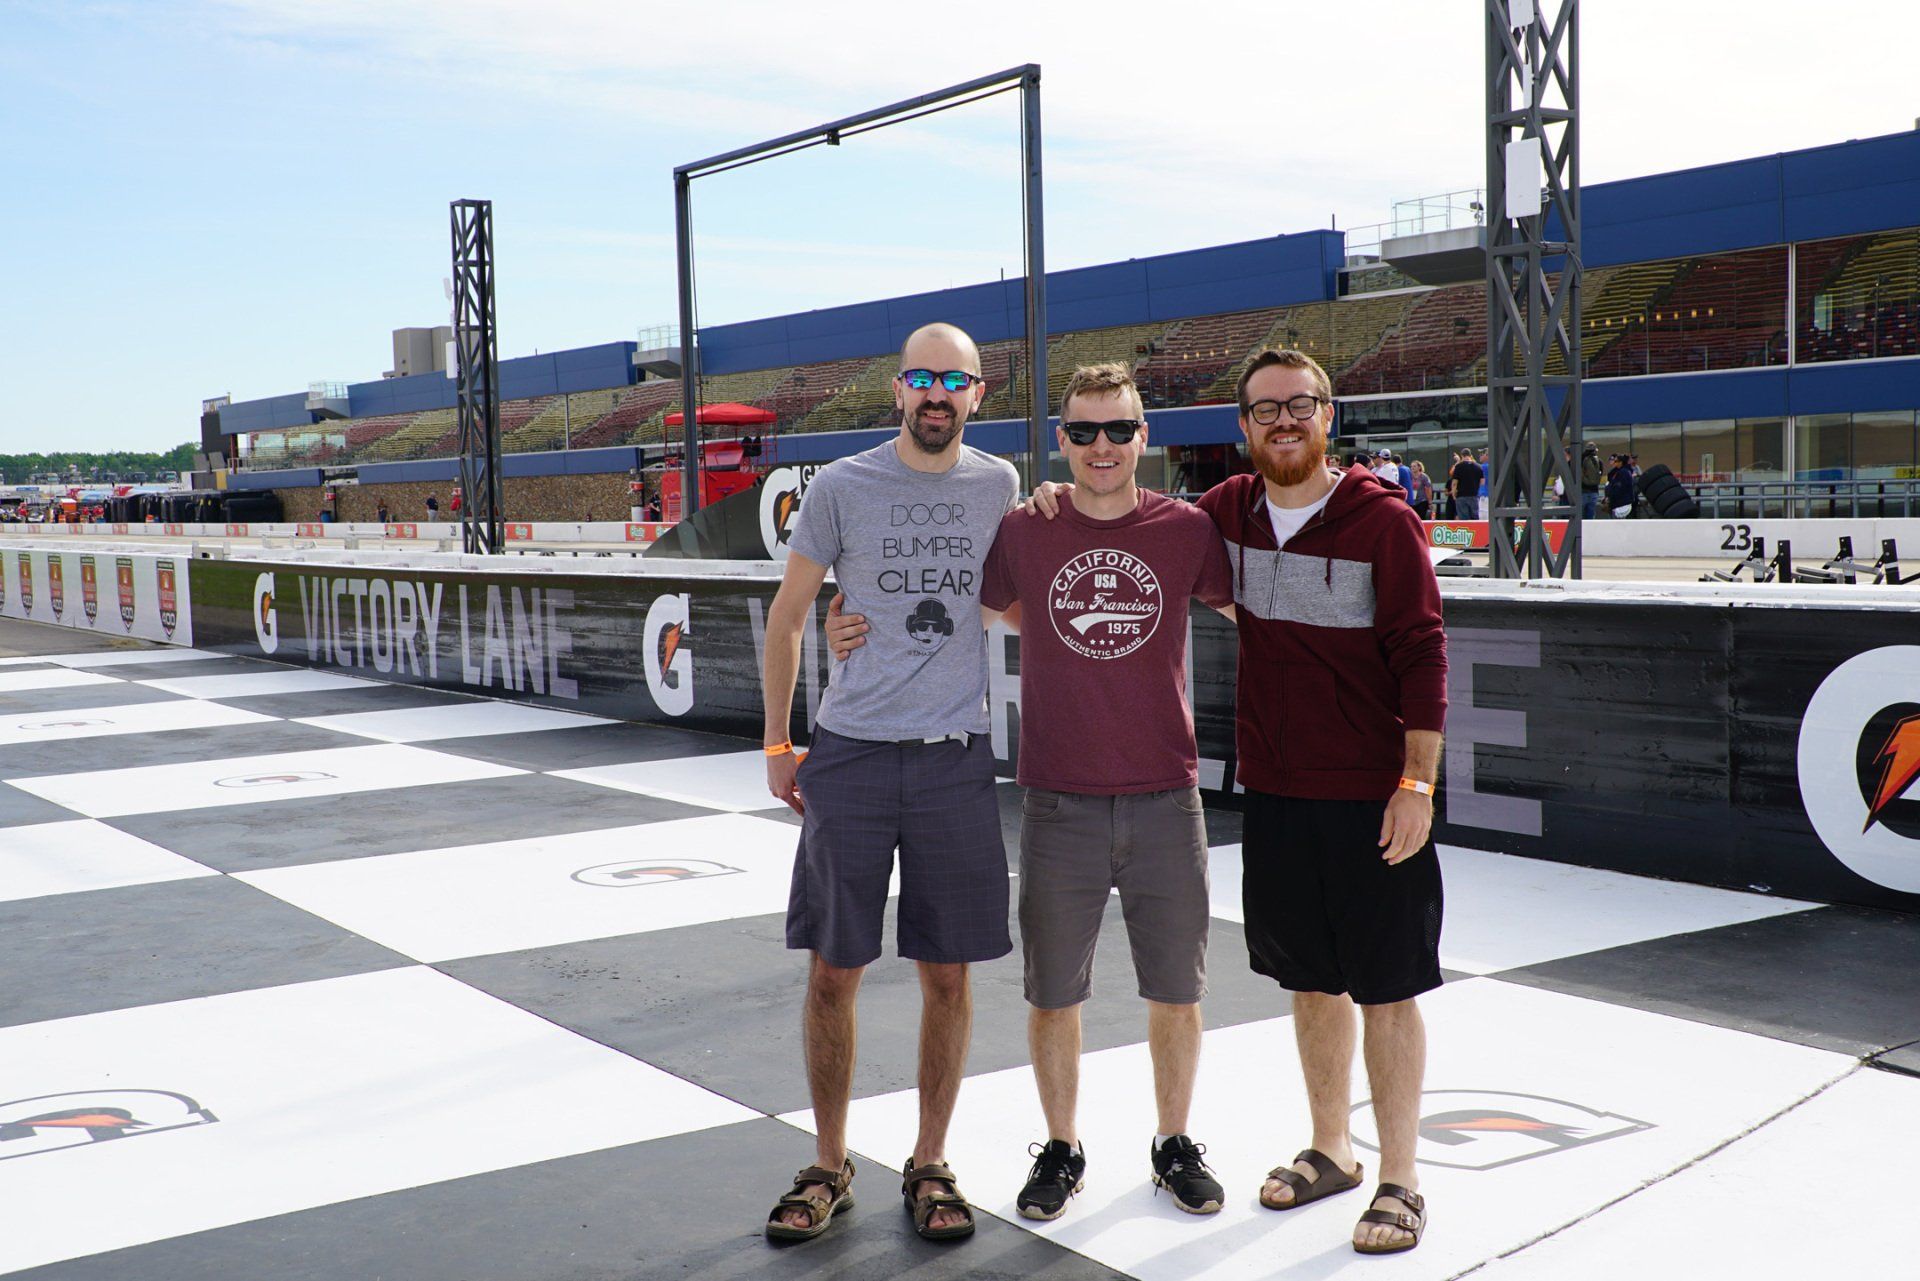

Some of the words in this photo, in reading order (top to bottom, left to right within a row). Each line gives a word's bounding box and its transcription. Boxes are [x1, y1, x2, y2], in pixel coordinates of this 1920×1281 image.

[891, 503, 967, 527] DOOR.
[1432, 525, 1473, 547] O'Reilly
[1721, 524, 1751, 550] 23
[883, 536, 975, 559] BUMPER.
[877, 569, 974, 596] CLEAR.
[1055, 552, 1157, 595] CALIFORNIA
[1094, 574, 1117, 588] USA
[1053, 591, 1085, 609] San
[1089, 592, 1158, 612] Francisco
[161, 612, 176, 627] 400
[1108, 623, 1140, 634] 1975
[299, 575, 442, 678] VICTORY
[458, 584, 578, 699] LANE
[1064, 635, 1111, 656] AUTHENTIC
[1114, 636, 1142, 655] BRAND
